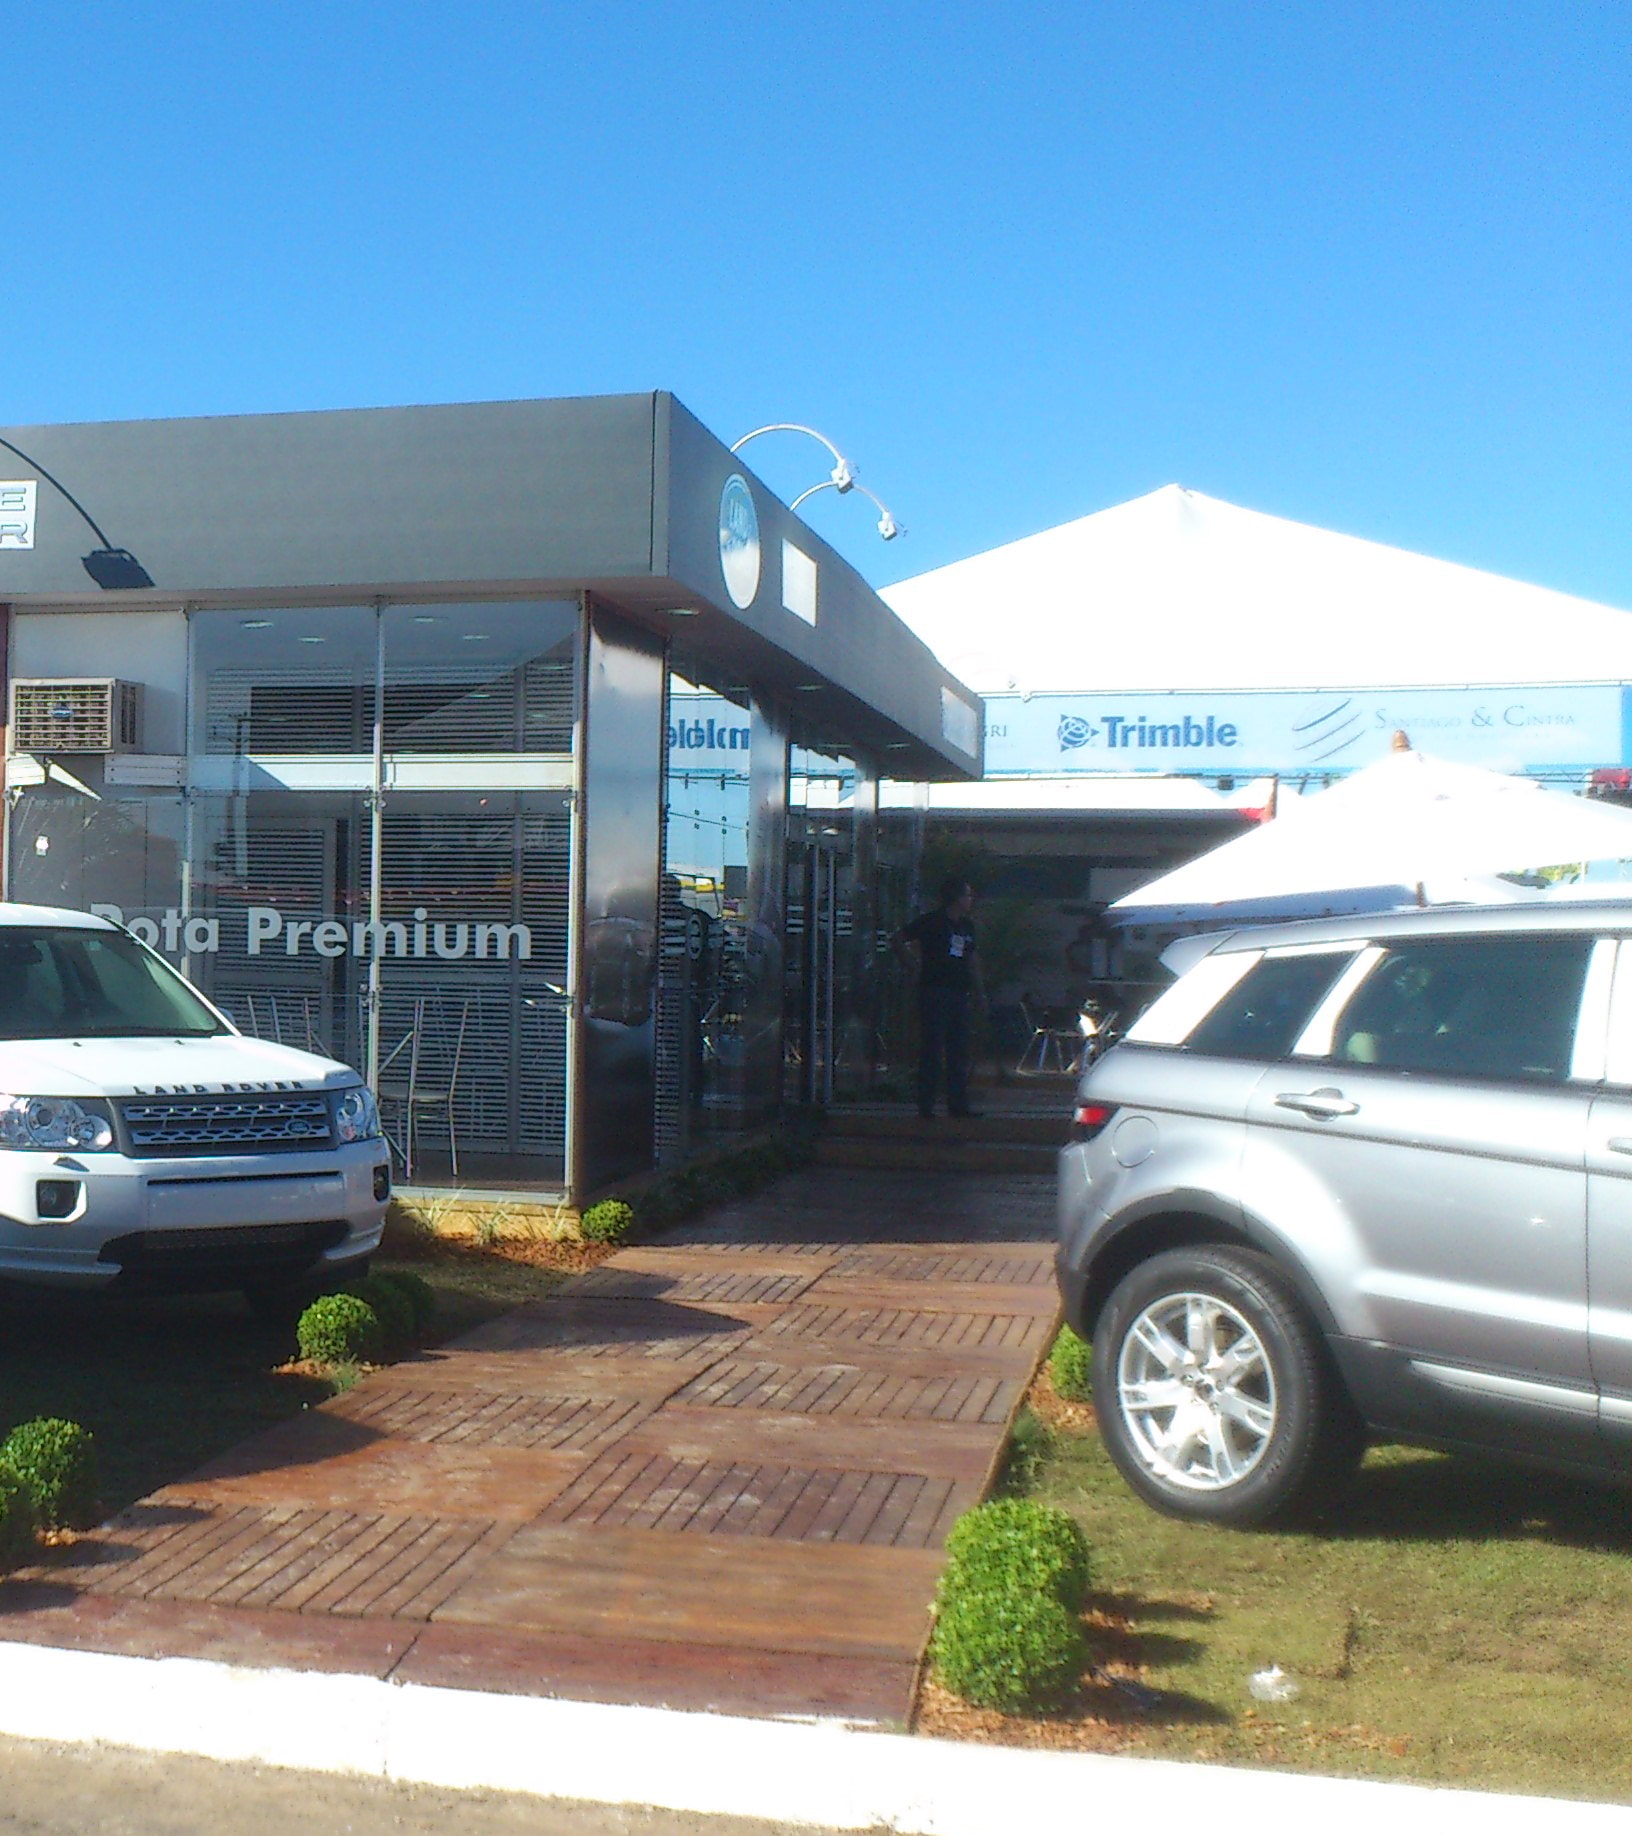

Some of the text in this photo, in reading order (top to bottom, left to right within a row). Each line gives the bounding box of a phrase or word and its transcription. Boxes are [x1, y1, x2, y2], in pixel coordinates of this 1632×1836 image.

[1472, 706, 1493, 727] &
[1504, 705, 1575, 727] CINTRA
[1101, 716, 1237, 748] Trimble
[248, 907, 532, 960] Premium
[133, 1081, 304, 1096] LAND ROVER
